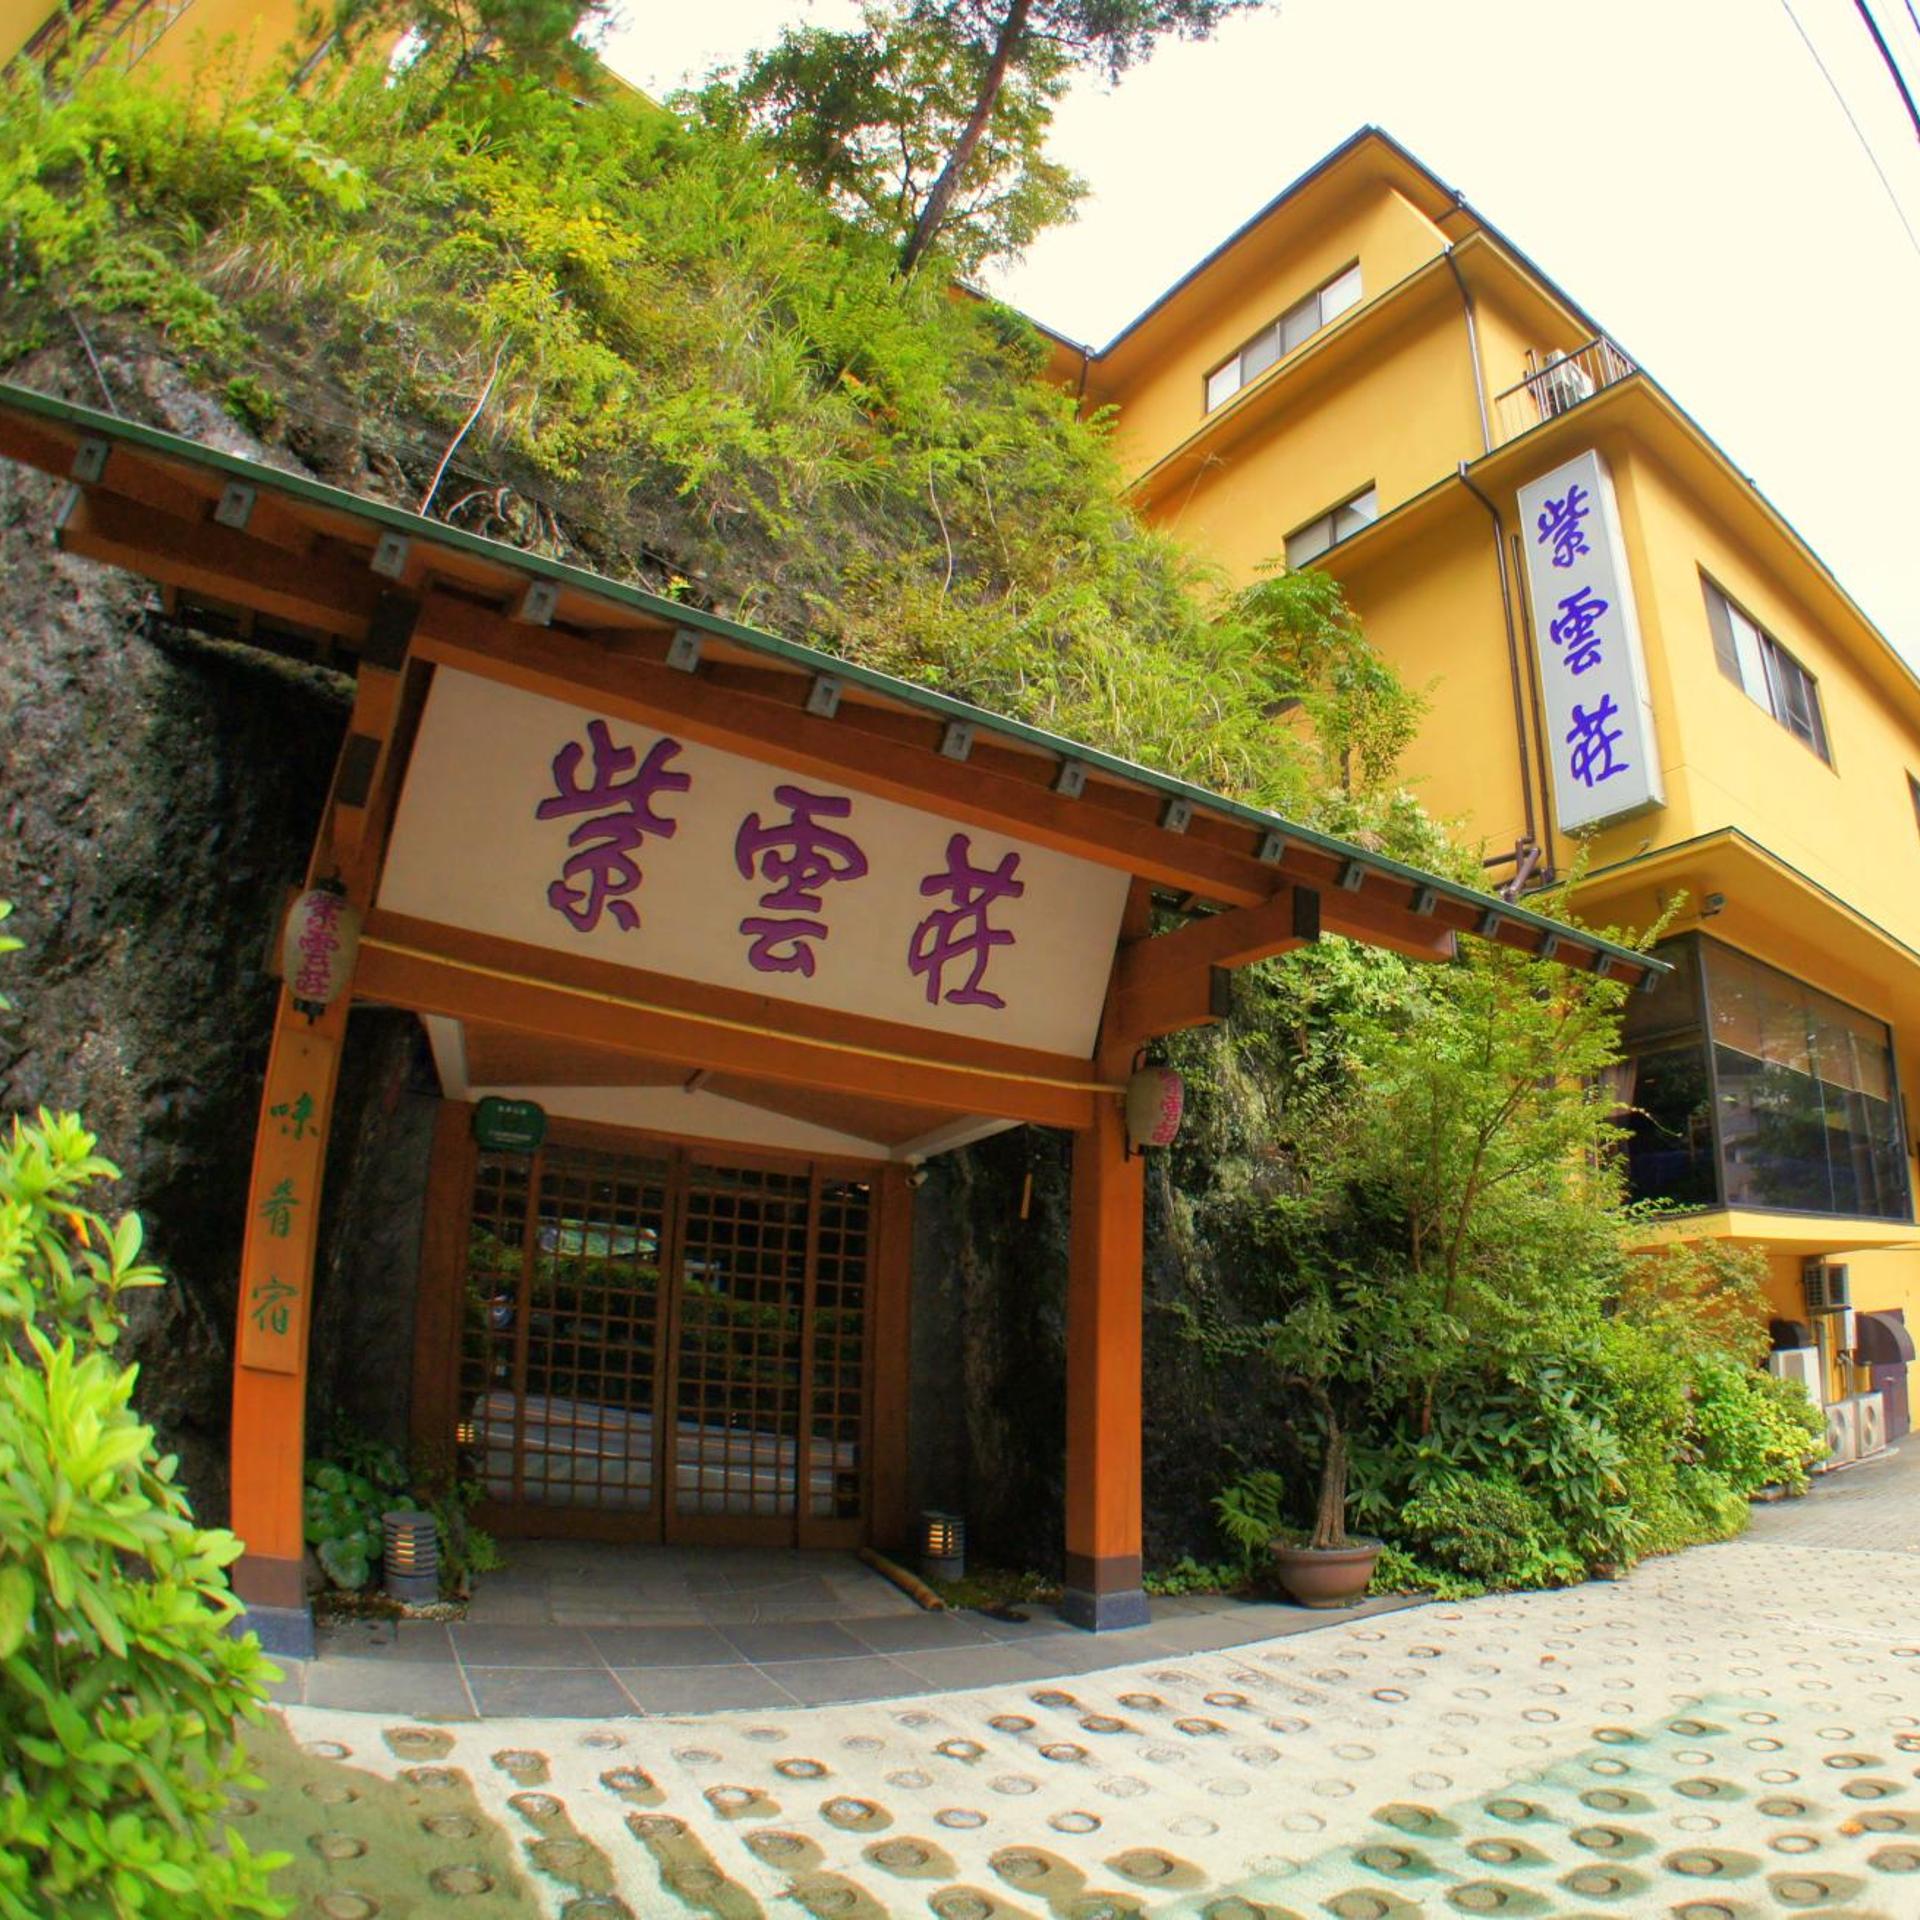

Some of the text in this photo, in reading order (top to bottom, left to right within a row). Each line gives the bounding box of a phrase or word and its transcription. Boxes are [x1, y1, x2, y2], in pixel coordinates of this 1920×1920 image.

[1538, 485, 1629, 787] 紫雲荘
[536, 720, 1024, 1009] 紫雲荘
